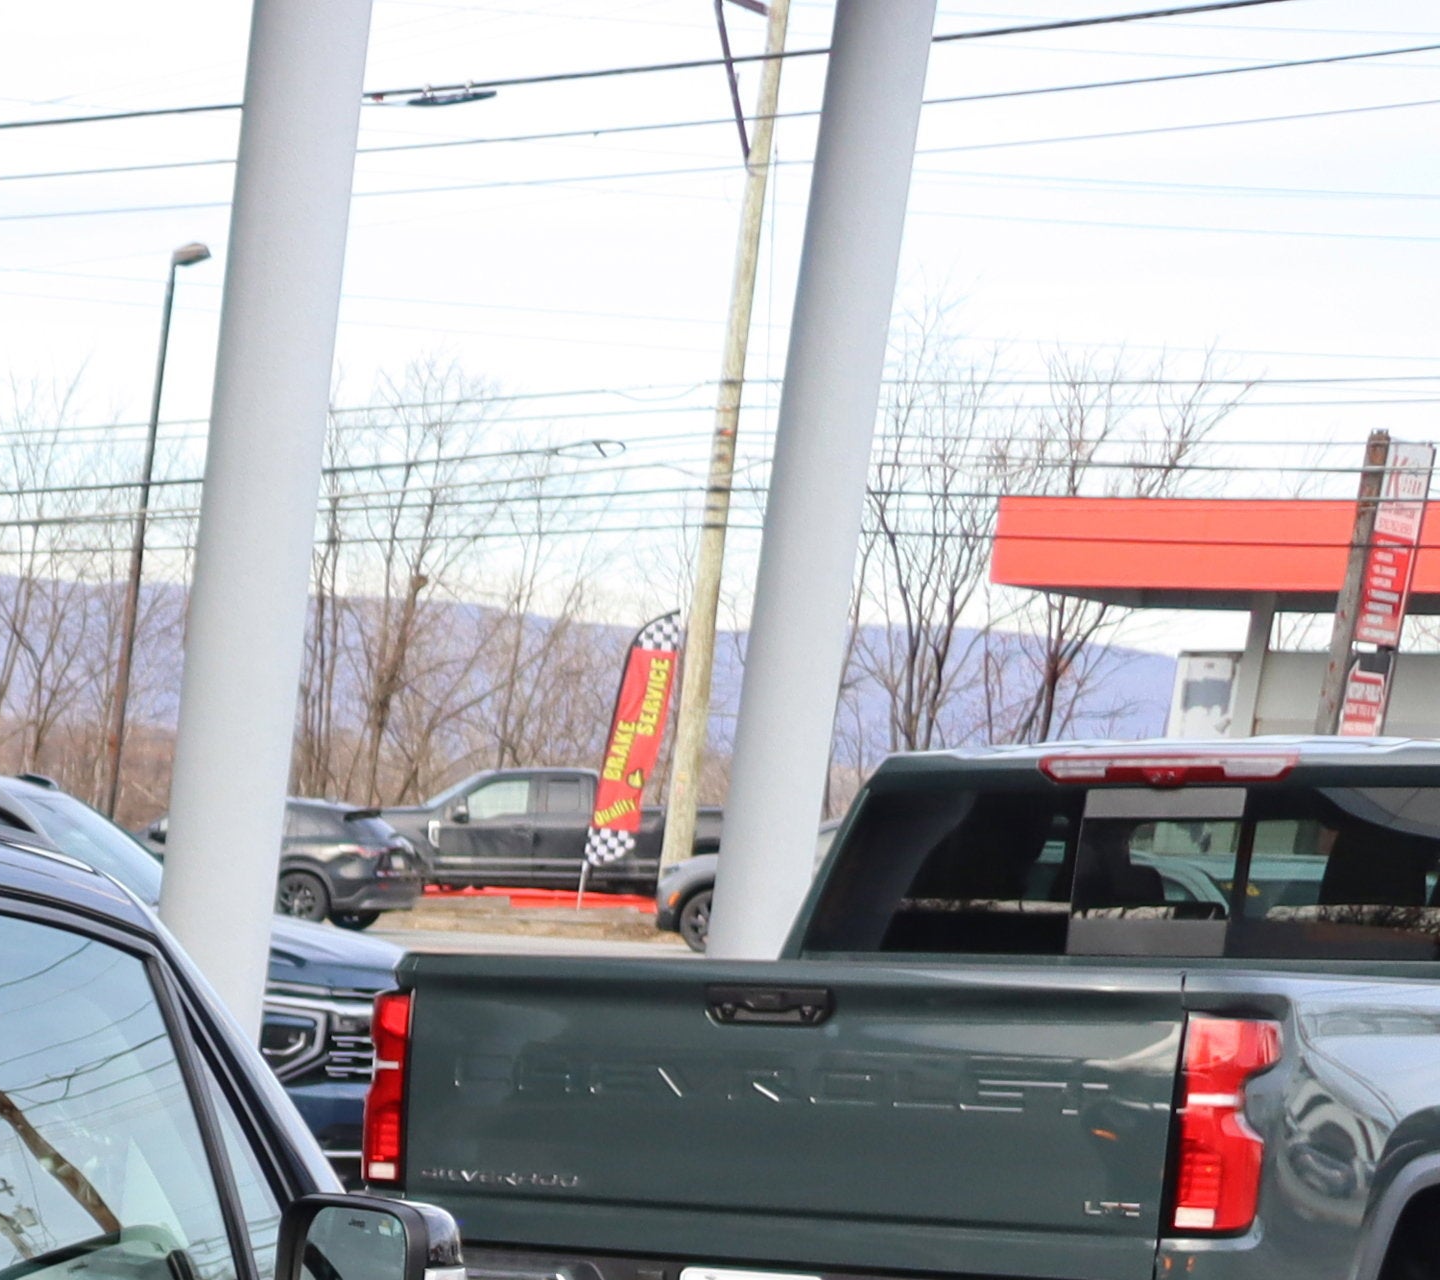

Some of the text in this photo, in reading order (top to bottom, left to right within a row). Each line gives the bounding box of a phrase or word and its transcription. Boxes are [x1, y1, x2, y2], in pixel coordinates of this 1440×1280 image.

[636, 658, 671, 737] SERVICE
[602, 719, 637, 781] BRAKE
[594, 797, 637, 827] Quality
